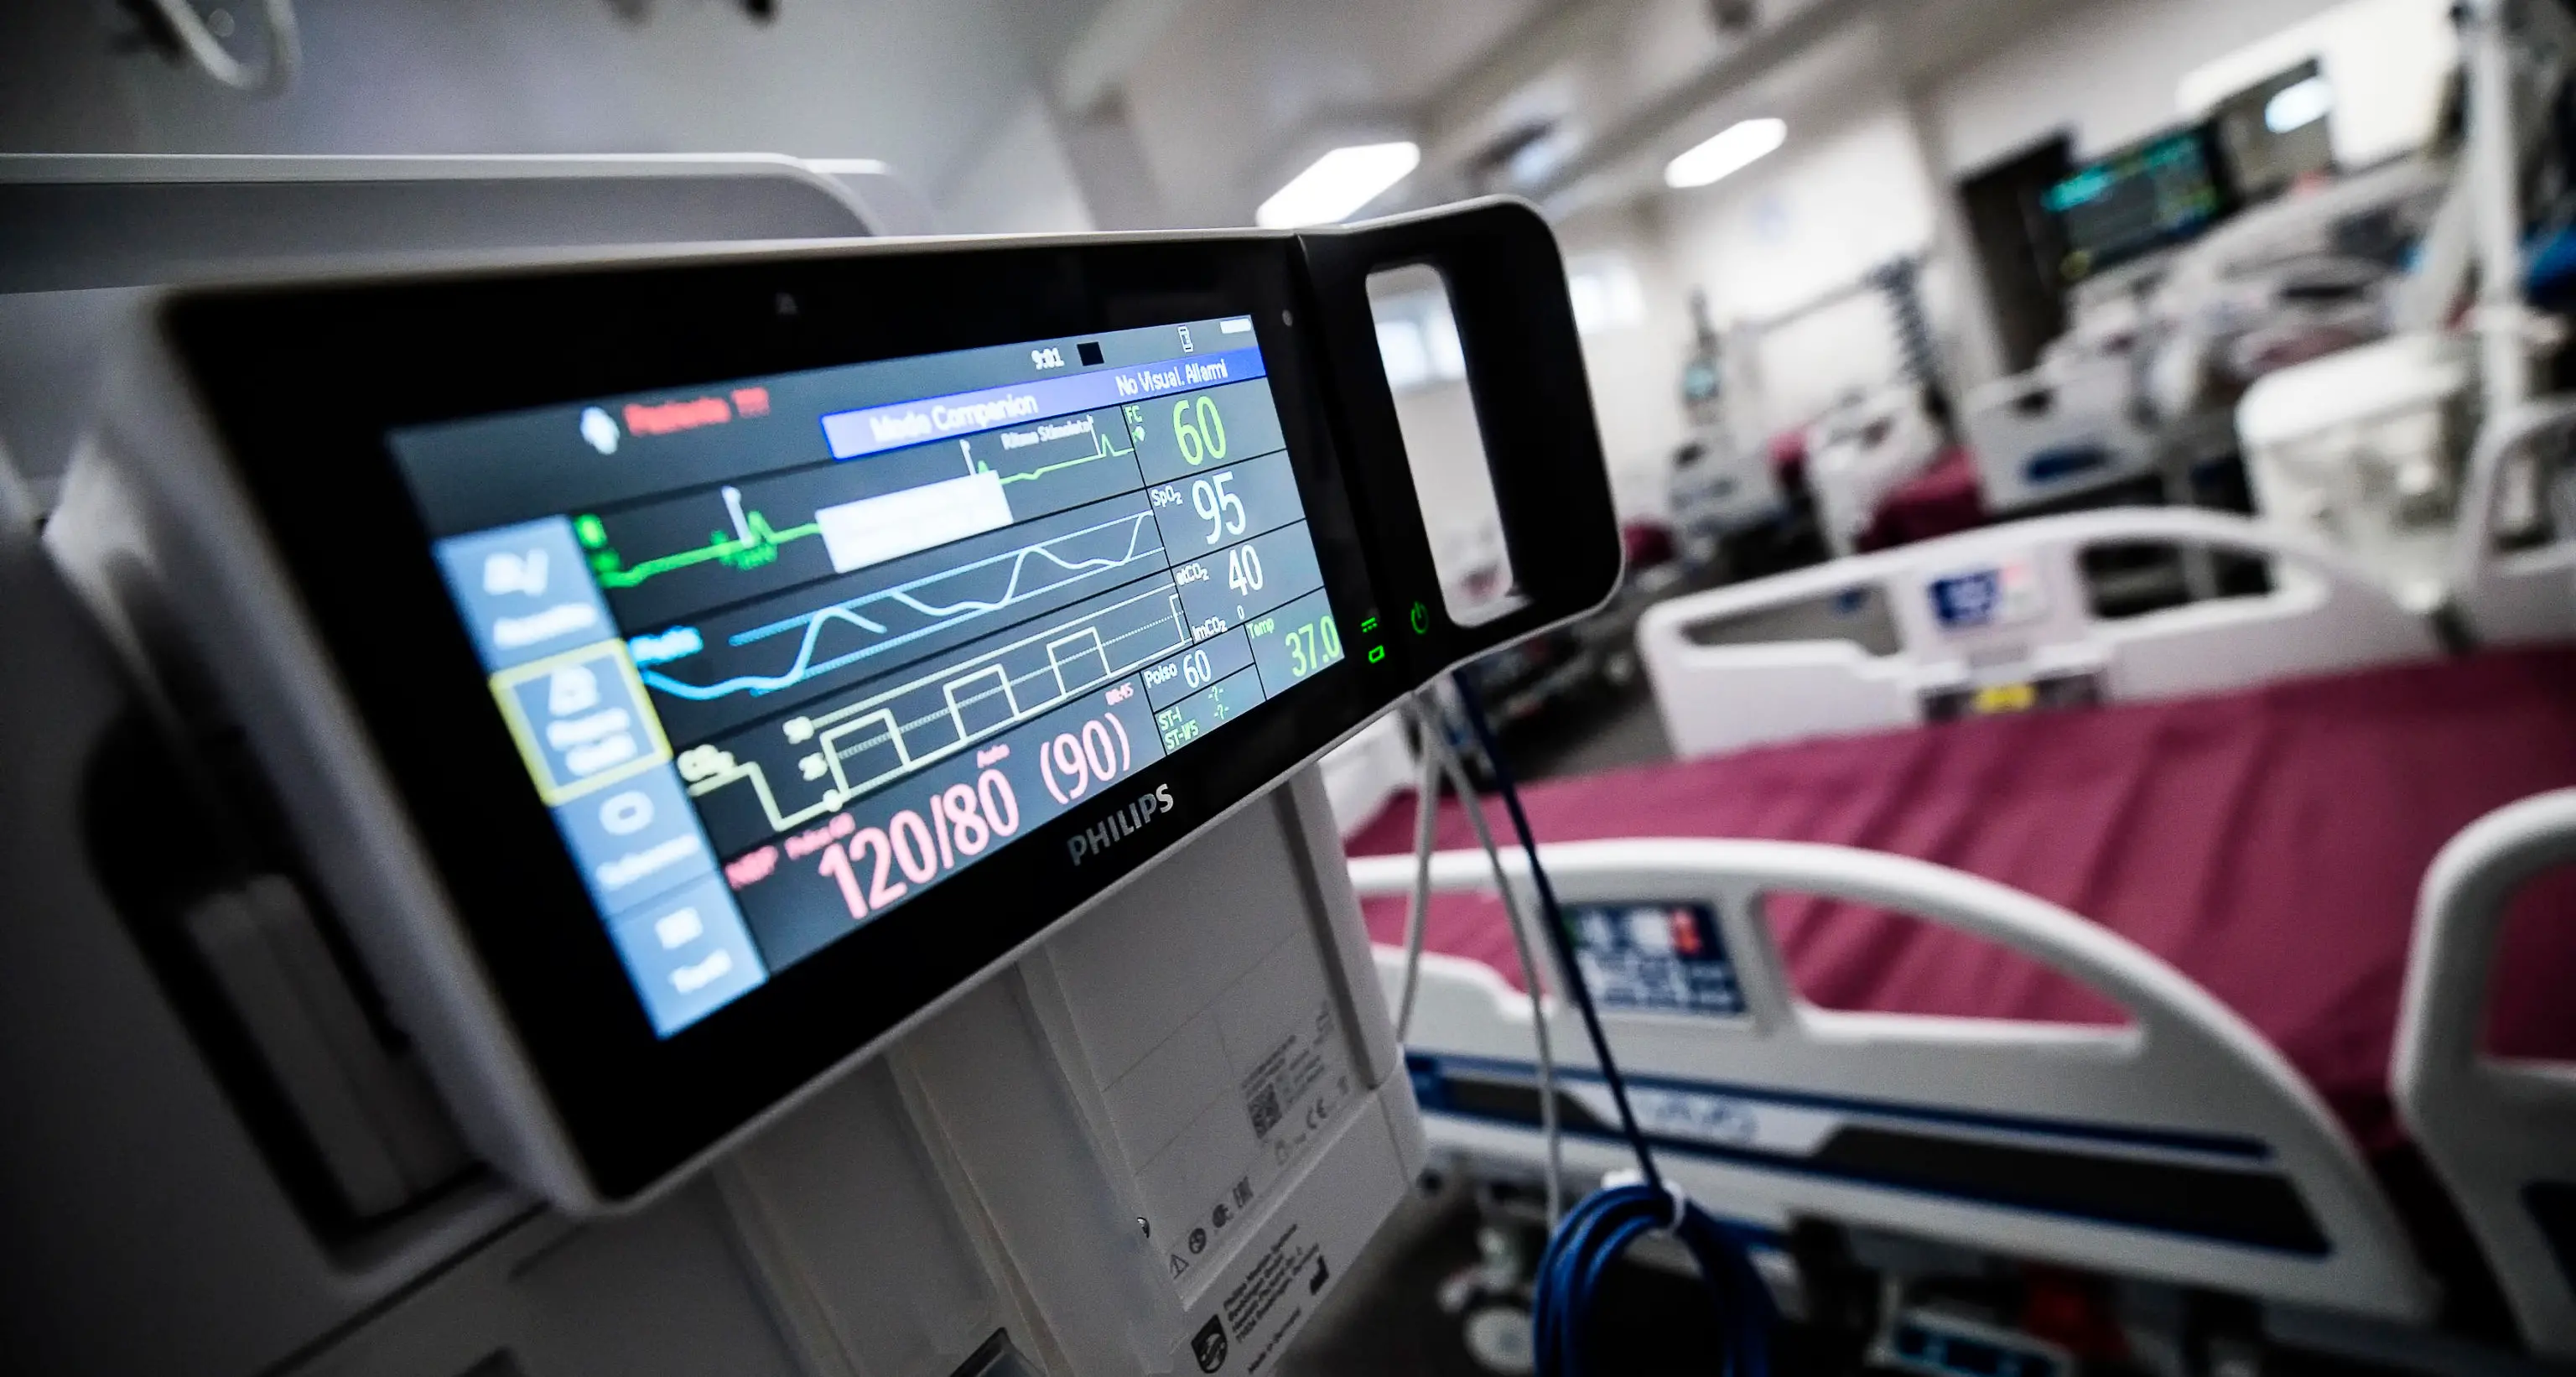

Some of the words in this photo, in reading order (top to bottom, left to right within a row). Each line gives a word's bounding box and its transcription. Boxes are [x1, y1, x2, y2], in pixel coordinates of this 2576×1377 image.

[1116, 376, 1139, 397] No
[1185, 358, 1228, 385] Allarmi
[931, 394, 1039, 429] Companion
[1124, 405, 1143, 423] FC
[1172, 396, 1227, 466] 60
[1192, 471, 1246, 545] 95
[1228, 544, 1264, 596] 40
[1236, 605, 1245, 621] 0
[1247, 617, 1275, 639] Temp
[1144, 663, 1178, 688] Polso
[1182, 649, 1212, 688] 60
[1285, 616, 1341, 678] 37.0
[818, 766, 1021, 921] 120/80
[1040, 712, 1131, 805] (90)
[1067, 782, 1175, 867] PHILIPS
